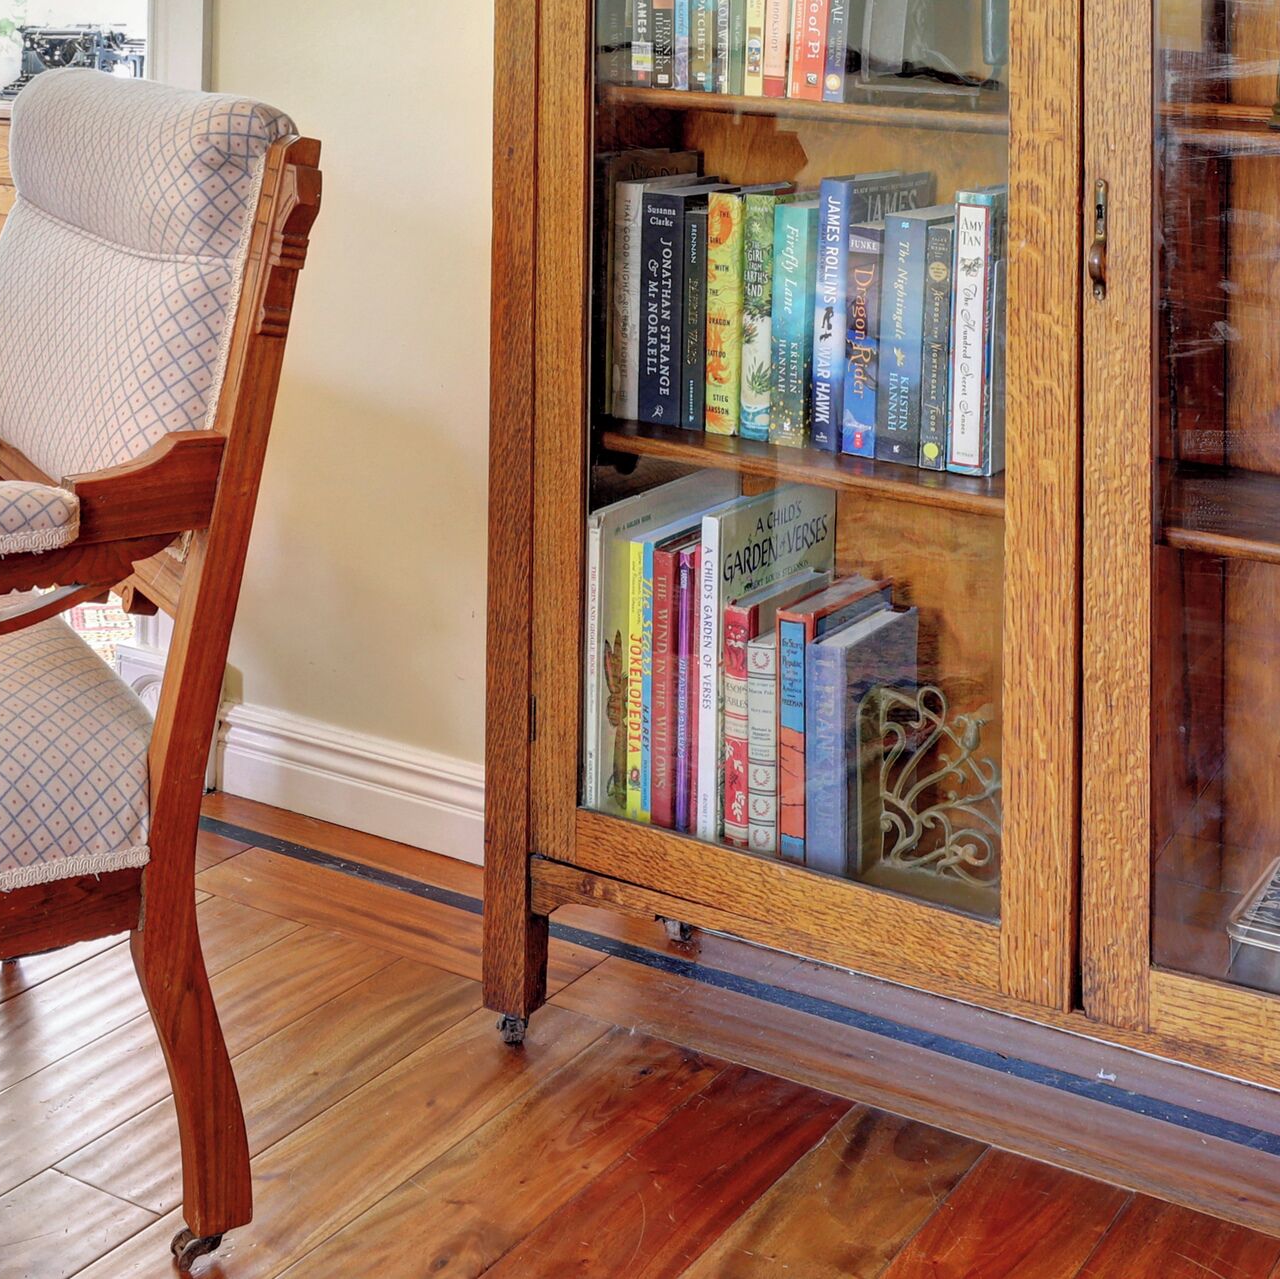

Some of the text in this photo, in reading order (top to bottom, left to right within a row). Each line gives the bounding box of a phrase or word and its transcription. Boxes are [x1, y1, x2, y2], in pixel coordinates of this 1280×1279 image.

[655, 12, 664, 72] HERBERT
[663, 19, 672, 64] FRANK
[771, 1, 780, 52] BOOKSHOP
[807, 41, 818, 59] Pi
[808, 17, 821, 35] of
[622, 199, 631, 258] THAT GOOD
[647, 204, 676, 216] Susanna
[649, 216, 674, 227] Clarke
[961, 217, 983, 231] AMY
[690, 223, 698, 264] BRENNAN
[747, 248, 763, 263] GIRL
[823, 195, 842, 304] JAMES ROLLINS
[850, 239, 877, 251] FUNKE
[961, 230, 982, 246] TAN
[709, 288, 719, 296] THE
[715, 264, 729, 272] WITH
[747, 282, 763, 297] END
[783, 224, 799, 314] Firefly Lane
[892, 240, 910, 340] The Nightingale
[646, 259, 659, 375] & Mr NORRELL
[659, 238, 673, 396] JONATHAN STRANGE
[847, 264, 875, 399] Dragon Rider
[777, 339, 787, 393] HANNAH
[788, 342, 799, 393] KRISTIN
[815, 345, 831, 425] WAR HAWK
[959, 284, 978, 435] The Hundred Secret Senses
[713, 394, 728, 403] STIEG
[887, 372, 898, 431] HANNAH
[898, 376, 910, 431] KRISTIN
[756, 501, 802, 533] A CHILD'S
[723, 514, 828, 584] GARDEN VERSES
[642, 576, 653, 677] The Stars
[702, 547, 713, 710] A CHILD'S GARDEN OF VERSES
[628, 633, 642, 754] JOKELOPEDIA
[654, 575, 668, 790] THE WIND IN THE WILLOWS
